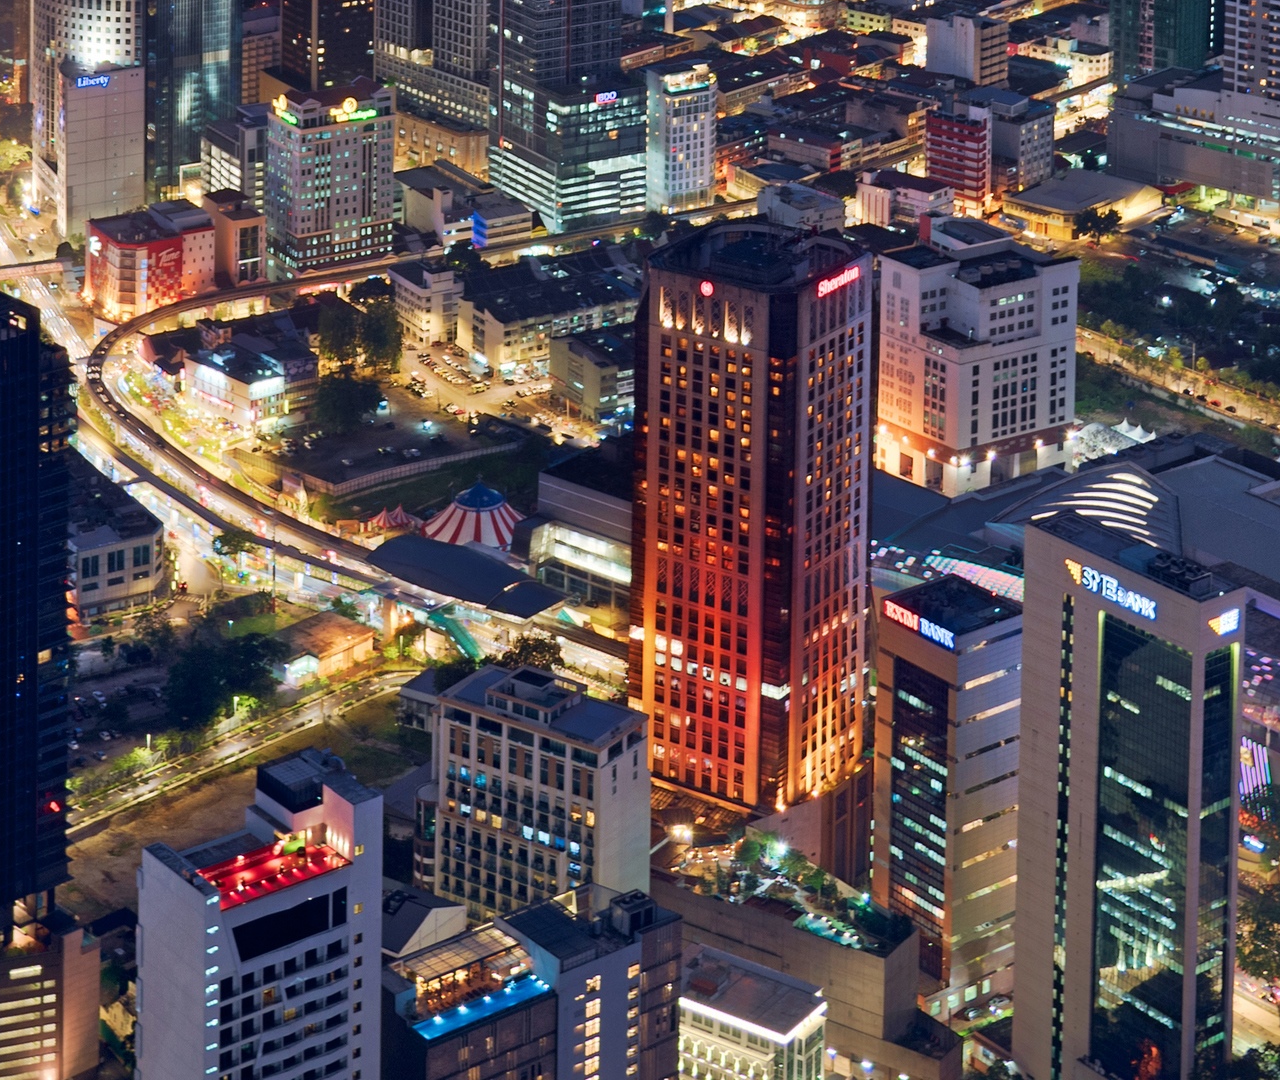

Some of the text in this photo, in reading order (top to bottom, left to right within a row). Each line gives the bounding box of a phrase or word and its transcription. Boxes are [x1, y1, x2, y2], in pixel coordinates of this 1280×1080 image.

[77, 76, 110, 88] Liberty
[598, 91, 617, 102] BDO
[818, 266, 859, 297] Sheraton
[885, 600, 955, 648] EXIM BANK
